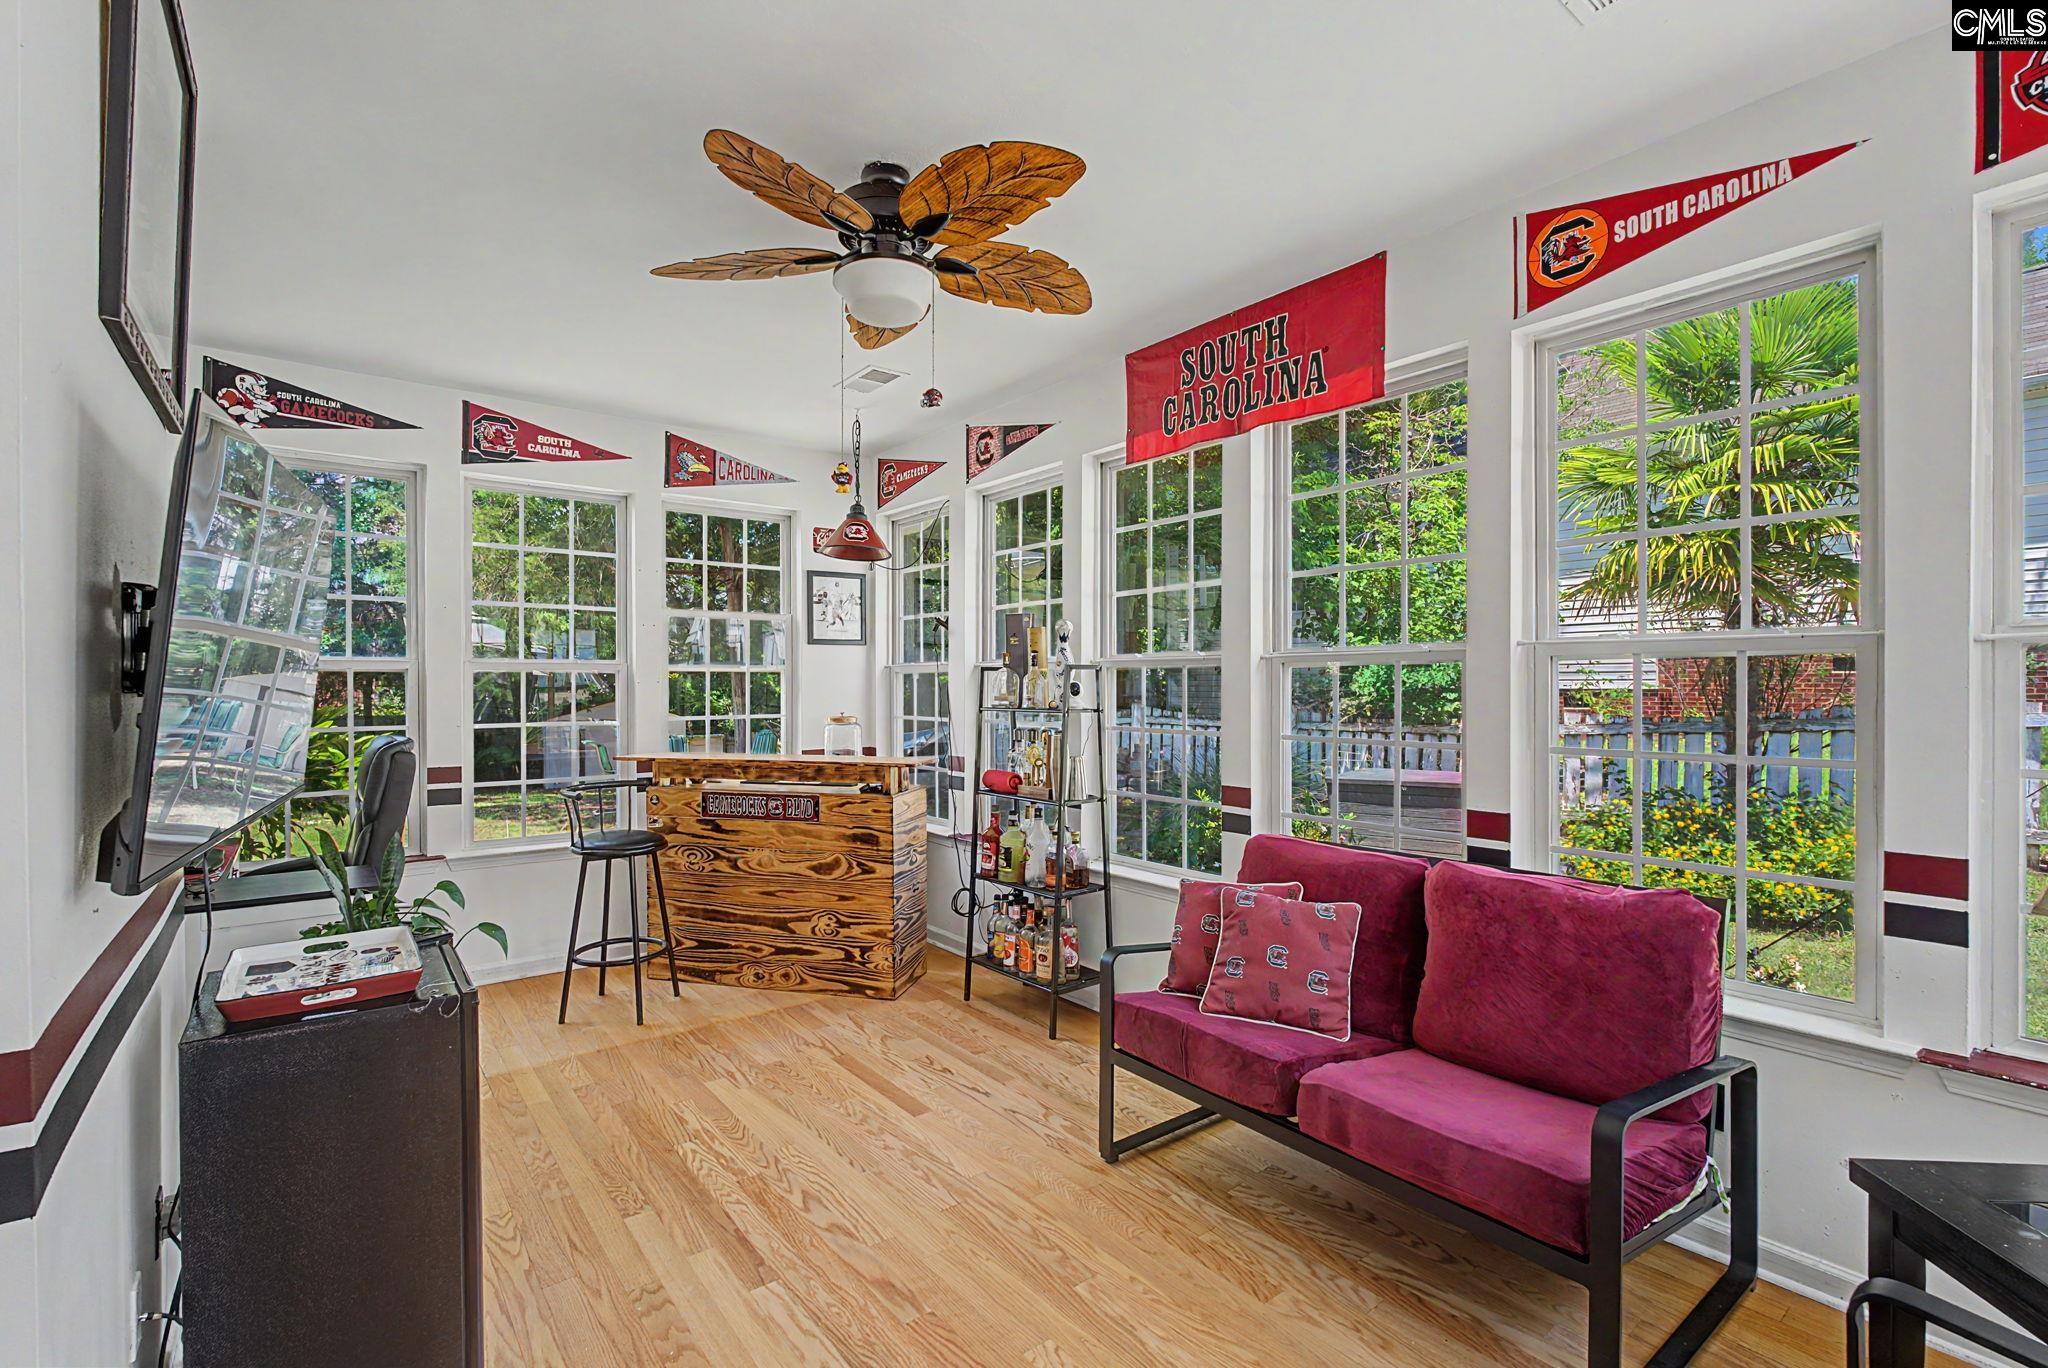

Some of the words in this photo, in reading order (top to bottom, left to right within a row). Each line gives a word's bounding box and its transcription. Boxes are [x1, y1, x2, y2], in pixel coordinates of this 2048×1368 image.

[1613, 200, 1678, 244] SOUTH
[1682, 157, 1793, 219] CAROLINA
[1180, 313, 1288, 390] SOUTH
[276, 391, 302, 402] SOUTH
[305, 396, 341, 409] CAROLINA
[1162, 350, 1328, 438] CAROLINA
[280, 400, 375, 428] GAMECOCKS
[527, 443, 581, 459] CAROLINA
[537, 434, 572, 447] SOUTH
[718, 456, 775, 481] CAROLINA
[896, 464, 929, 483] GAMECOCKS
[708, 794, 767, 817] GAMECOCKS
[786, 797, 814, 819] BLVD
